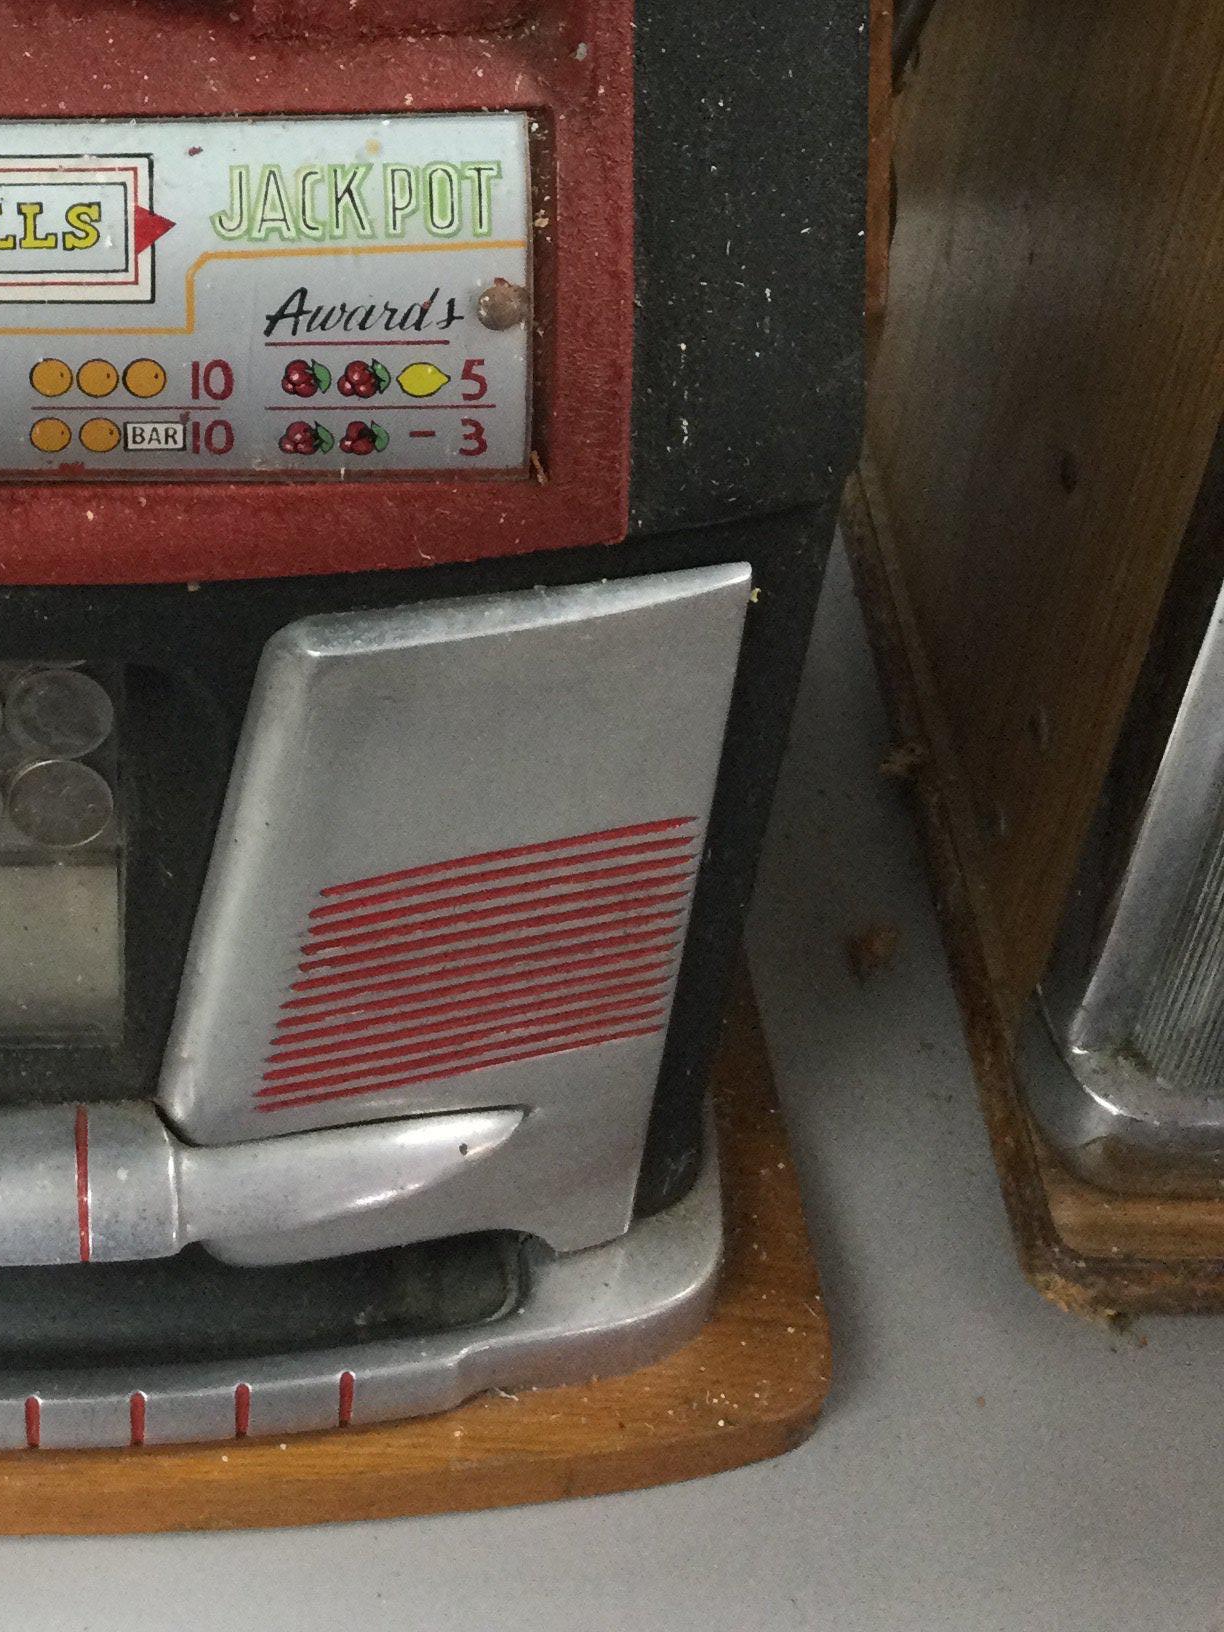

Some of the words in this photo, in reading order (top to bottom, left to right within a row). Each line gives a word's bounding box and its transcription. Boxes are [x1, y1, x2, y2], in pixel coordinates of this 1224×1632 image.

[263, 286, 464, 338] Awards
[190, 358, 235, 401] 10
[461, 358, 488, 402] 5
[130, 424, 178, 447] BAR
[191, 419, 235, 456] 10
[459, 418, 488, 457] 3
